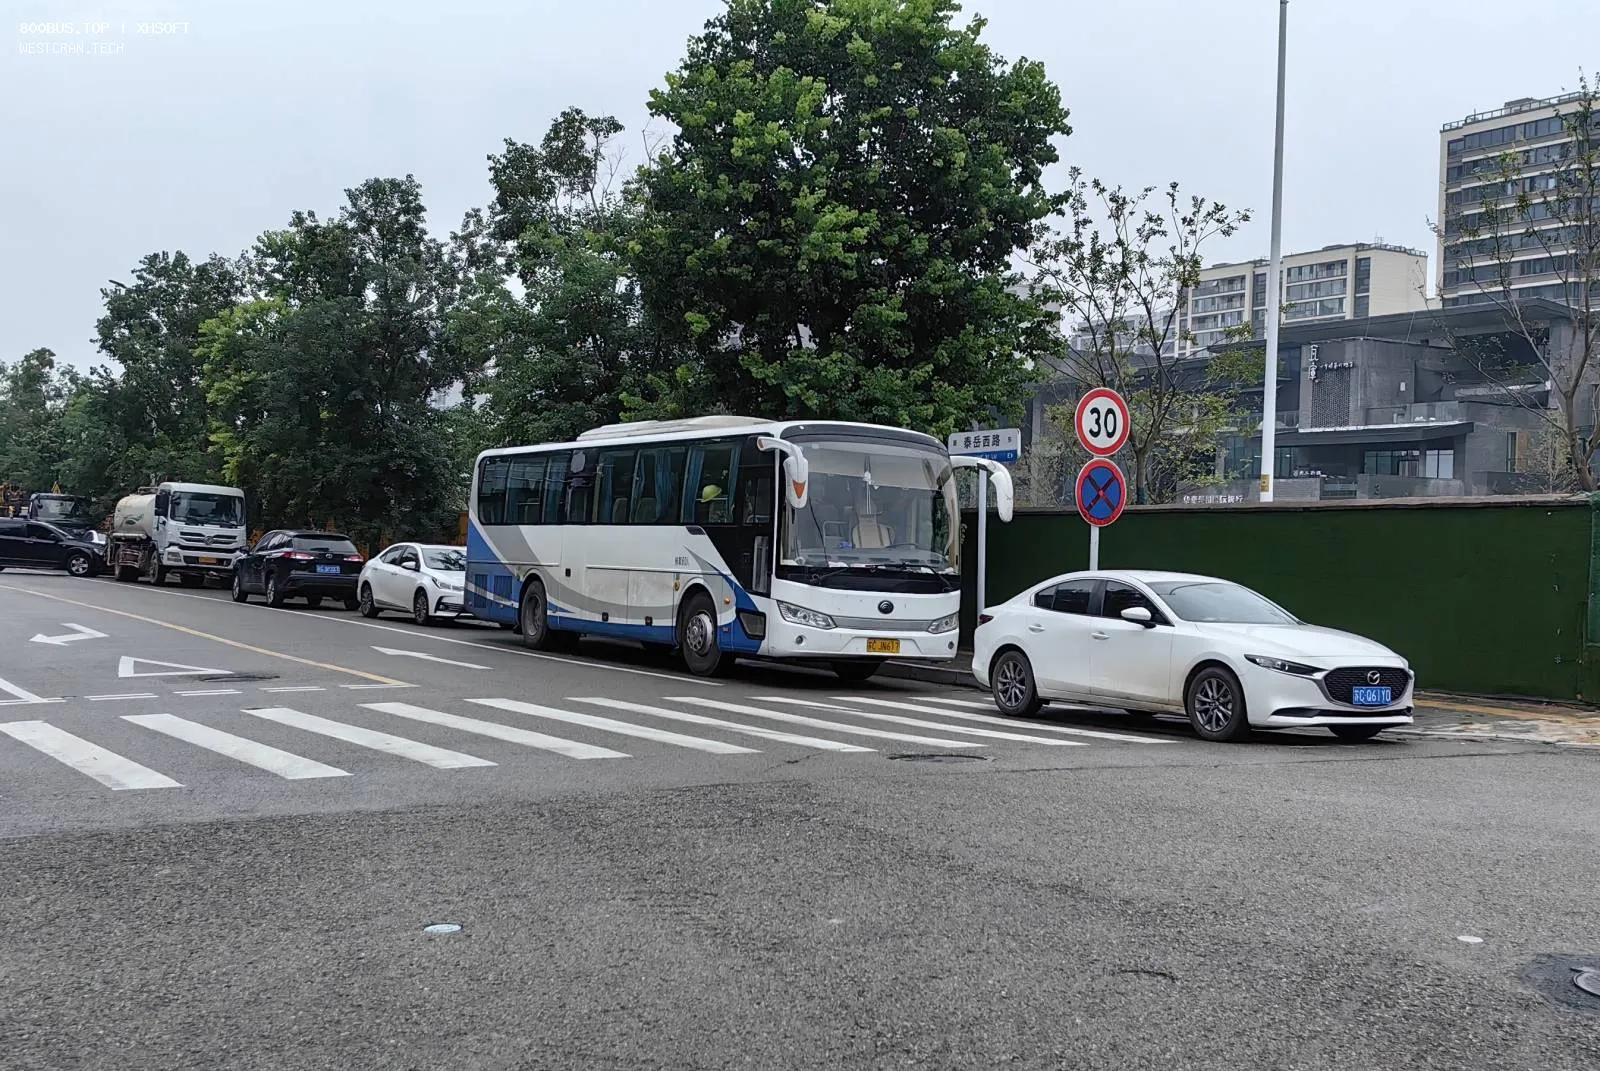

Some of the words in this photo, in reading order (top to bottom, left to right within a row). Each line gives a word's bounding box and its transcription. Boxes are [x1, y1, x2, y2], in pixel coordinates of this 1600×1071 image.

[1088, 406, 1117, 439] 30
[963, 433, 1001, 449] 泰岳西路
